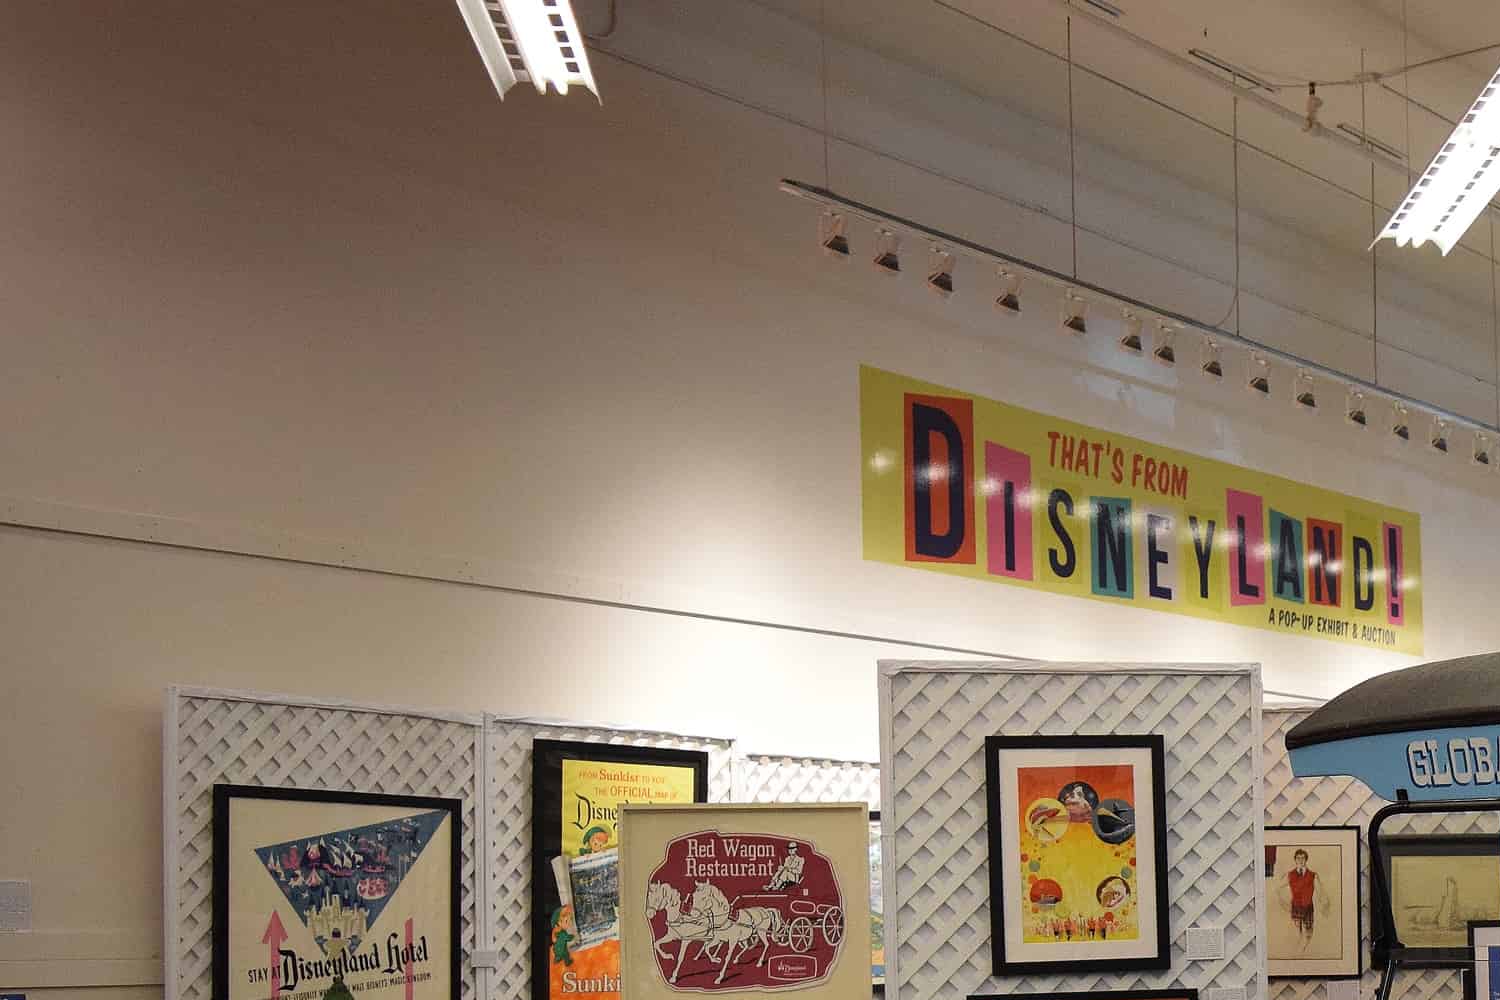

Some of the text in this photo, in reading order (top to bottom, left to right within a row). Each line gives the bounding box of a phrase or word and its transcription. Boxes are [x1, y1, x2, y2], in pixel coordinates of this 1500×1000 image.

[1047, 431, 1188, 500] THAT'S FROM
[912, 401, 1401, 618] DISNEYLAND!
[1268, 607, 1396, 646] A POP-UP EXHIBIT & AUCTION
[599, 769, 640, 783] Sunkist
[610, 785, 653, 800] OFFICIAL
[687, 838, 776, 862] Red Wagon
[684, 858, 775, 878] Restaurant
[248, 967, 269, 984] STAY
[278, 943, 380, 991] Disneyland
[382, 932, 429, 975] Hotel
[562, 970, 622, 994] Sunki
